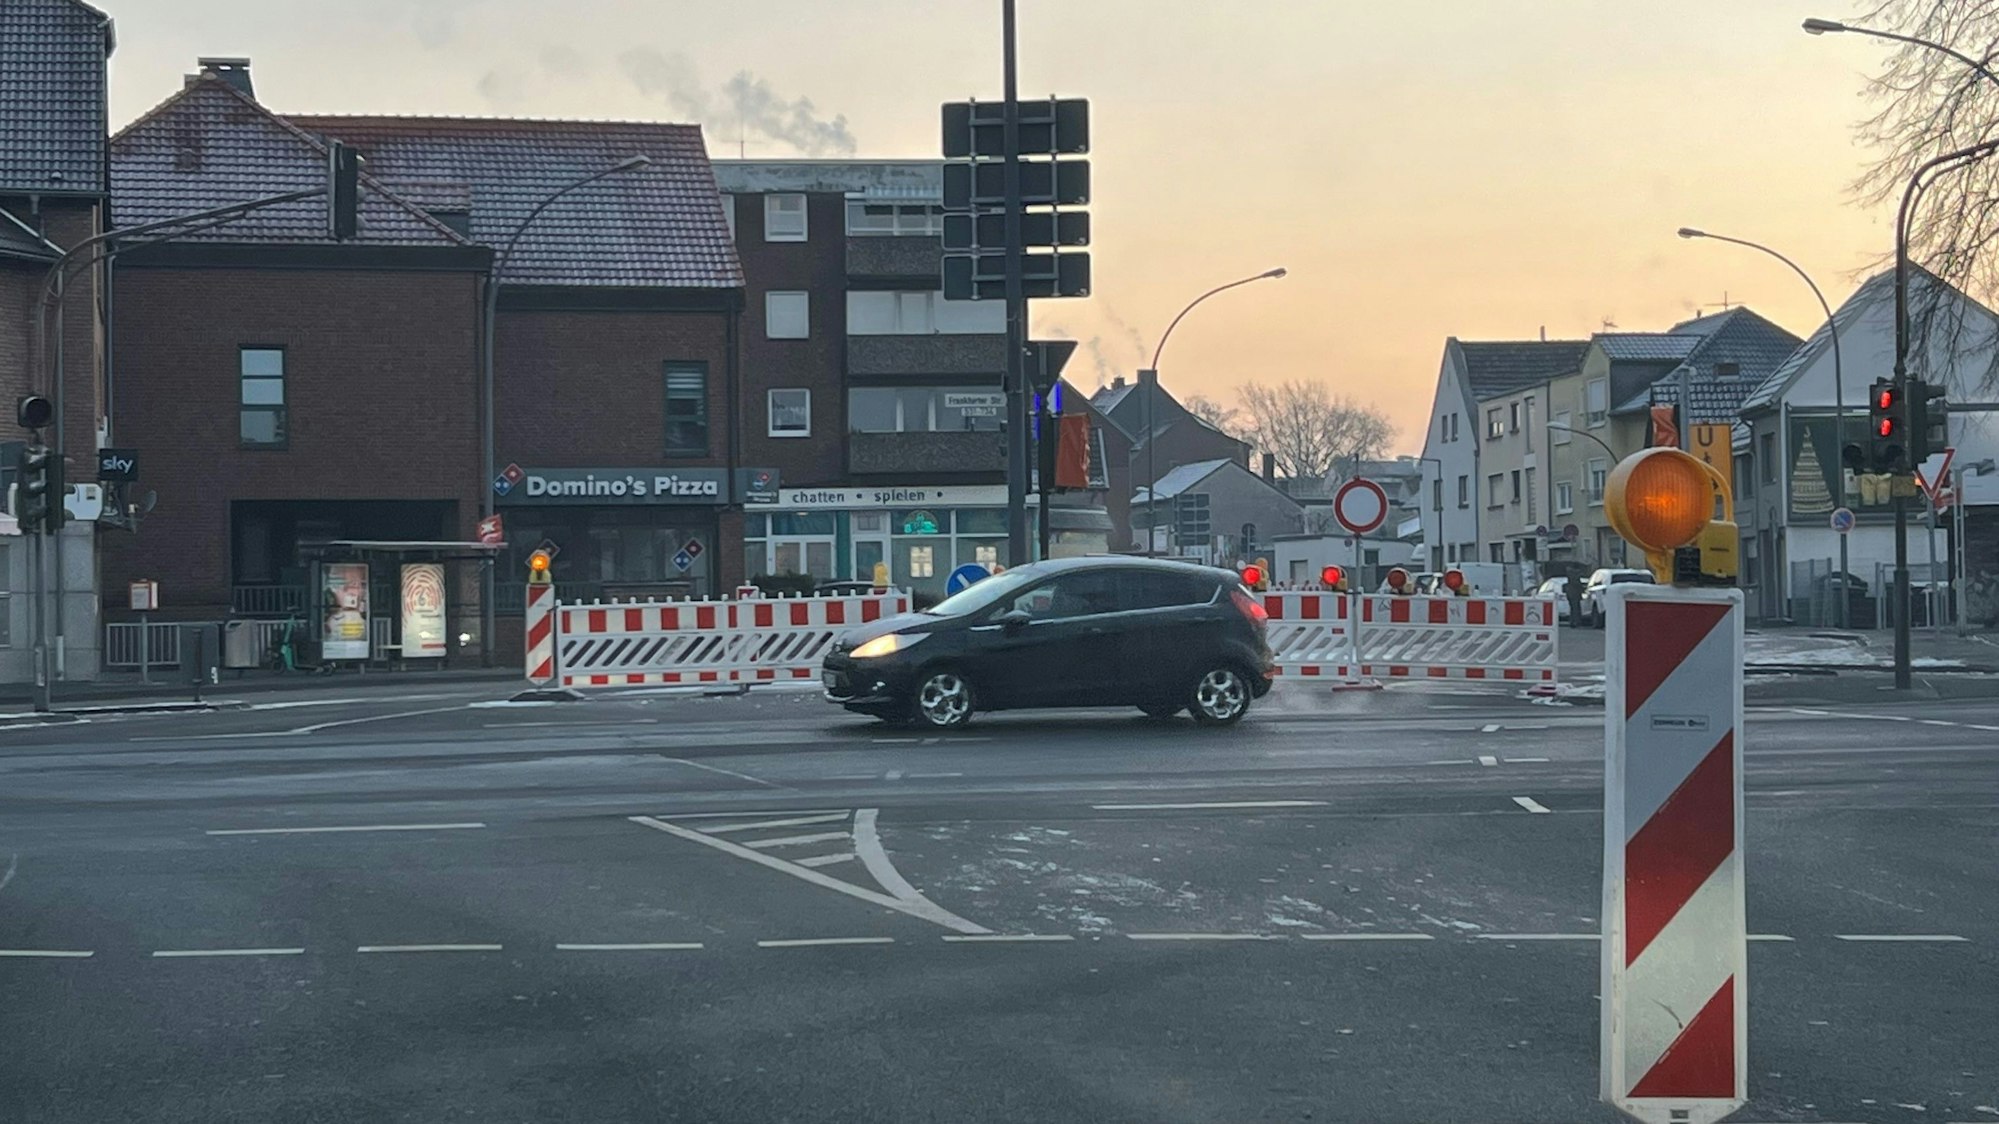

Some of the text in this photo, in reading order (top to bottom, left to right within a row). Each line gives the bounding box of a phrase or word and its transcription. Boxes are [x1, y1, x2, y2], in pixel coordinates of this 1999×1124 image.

[102, 455, 133, 474] sky
[526, 475, 718, 496] Domino's Pizza
[792, 491, 845, 503] chatten
[874, 490, 925, 505] spielen
